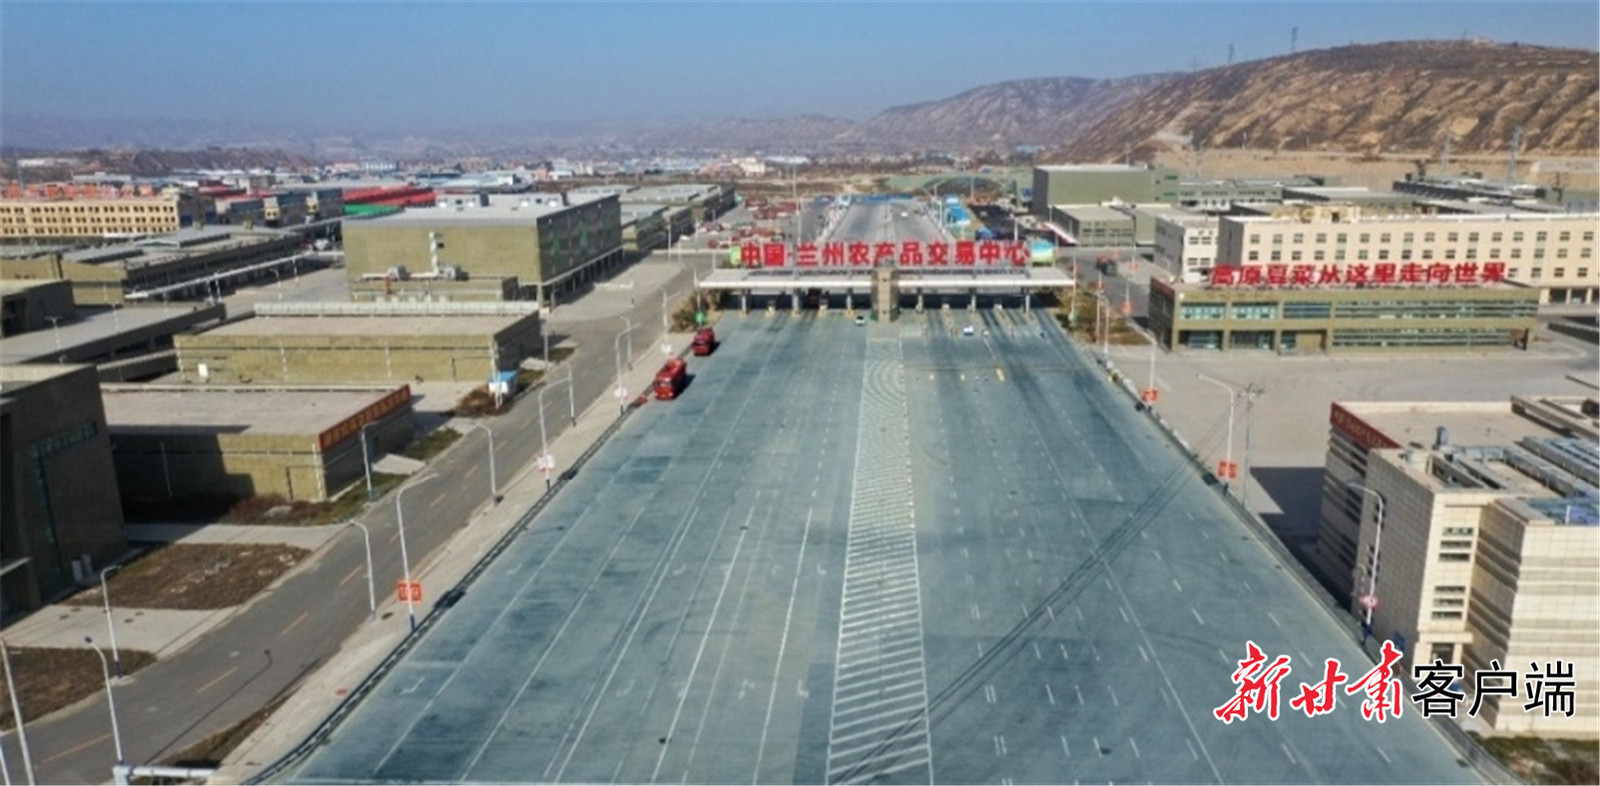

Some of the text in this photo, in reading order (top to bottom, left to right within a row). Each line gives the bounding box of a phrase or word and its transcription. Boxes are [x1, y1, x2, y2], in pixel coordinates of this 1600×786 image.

[1211, 262, 1506, 286] 高原夏菜从这里走向世界
